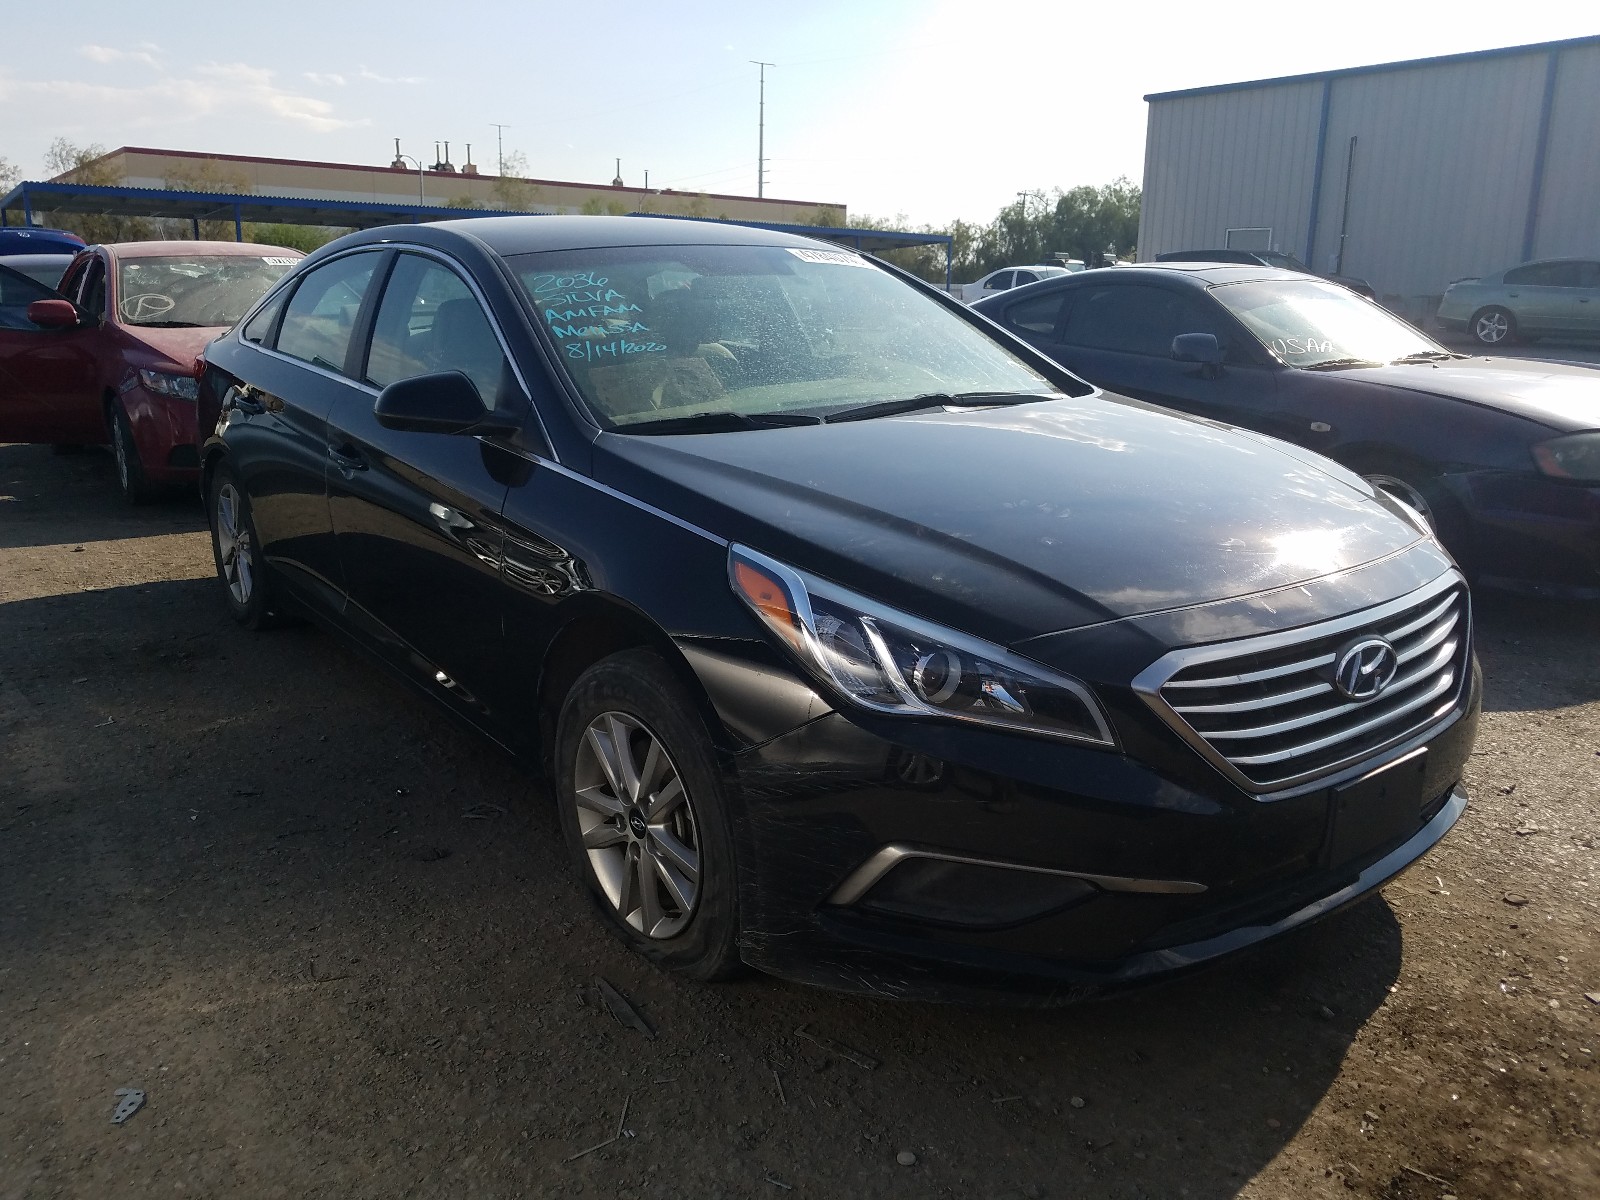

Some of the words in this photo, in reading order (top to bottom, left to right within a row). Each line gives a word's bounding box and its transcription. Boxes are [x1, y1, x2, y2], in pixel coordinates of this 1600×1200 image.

[534, 272, 608, 292] 2036
[545, 304, 643, 324] AMFAM
[565, 340, 667, 362] 8/14/2020
[1272, 337, 1336, 355] USAA
